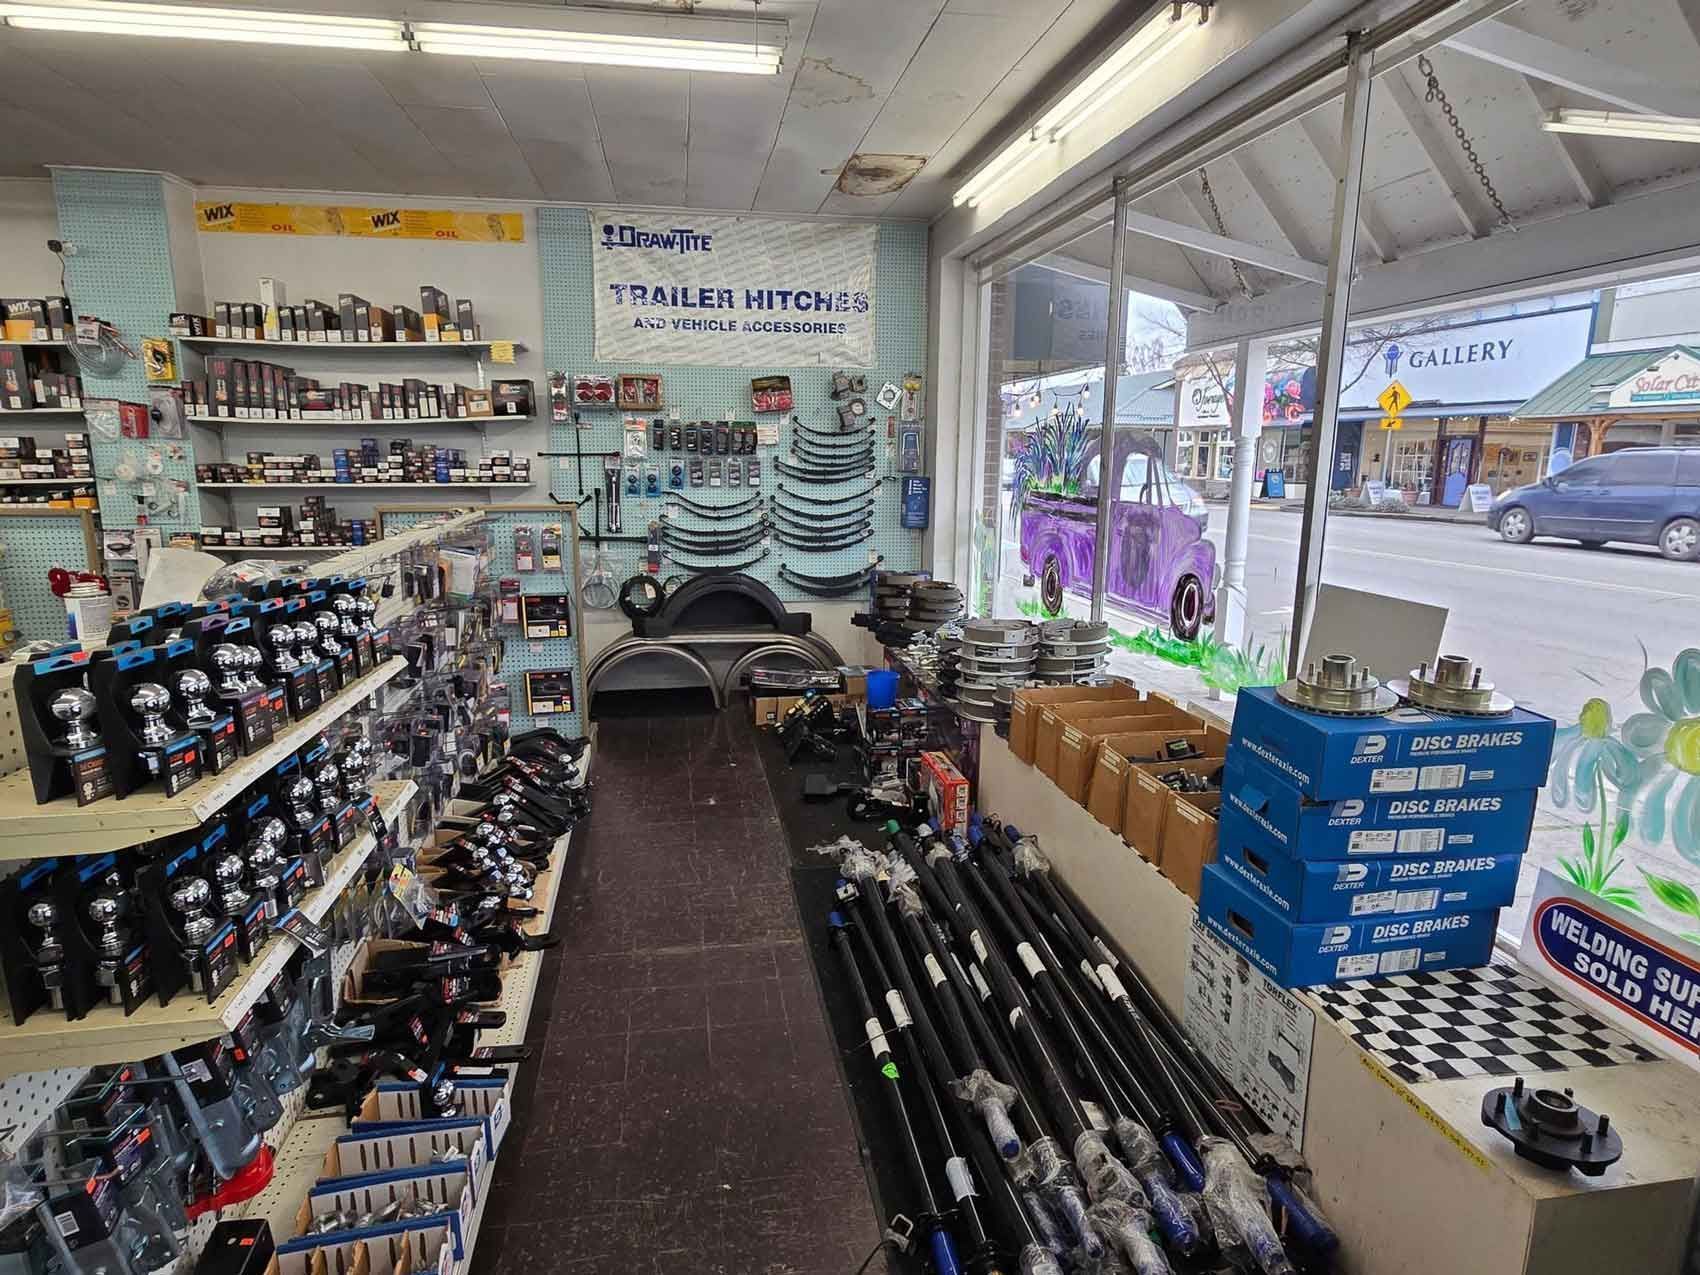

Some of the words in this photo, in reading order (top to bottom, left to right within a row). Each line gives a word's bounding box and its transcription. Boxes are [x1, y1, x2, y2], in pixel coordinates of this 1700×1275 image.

[204, 203, 234, 221] WIX
[371, 210, 400, 228] WIX
[271, 224, 296, 233] OIL
[435, 230, 459, 239] OIL
[8, 301, 31, 313] WIX
[609, 283, 735, 310] TRAILER
[745, 288, 869, 313] HITCHES
[192, 317, 201, 336] WIX
[633, 317, 666, 330] AND
[671, 318, 737, 333] VEHICLE
[742, 320, 847, 334] ACCESSORIES
[1409, 339, 1514, 369] GALLERY
[1635, 375, 1674, 392] Solar
[1411, 734, 1453, 751] DISC
[1455, 731, 1524, 749] BRAKES
[1350, 754, 1384, 764] DEXTER
[1388, 800, 1430, 815] DISC
[1433, 797, 1503, 813] BRAKES
[1328, 817, 1362, 826] DEXTER
[1391, 862, 1431, 878] DISC
[1432, 857, 1496, 874] BRAKES
[1333, 882, 1365, 891] DEXTER
[1372, 921, 1411, 939] DISC
[1412, 915, 1471, 934] BRAKES
[1318, 944, 1350, 954] DEXTER
[1551, 908, 1649, 980] WELDING
[1573, 952, 1642, 1004] SOLD
[1263, 979, 1298, 1011] TORFLEX
